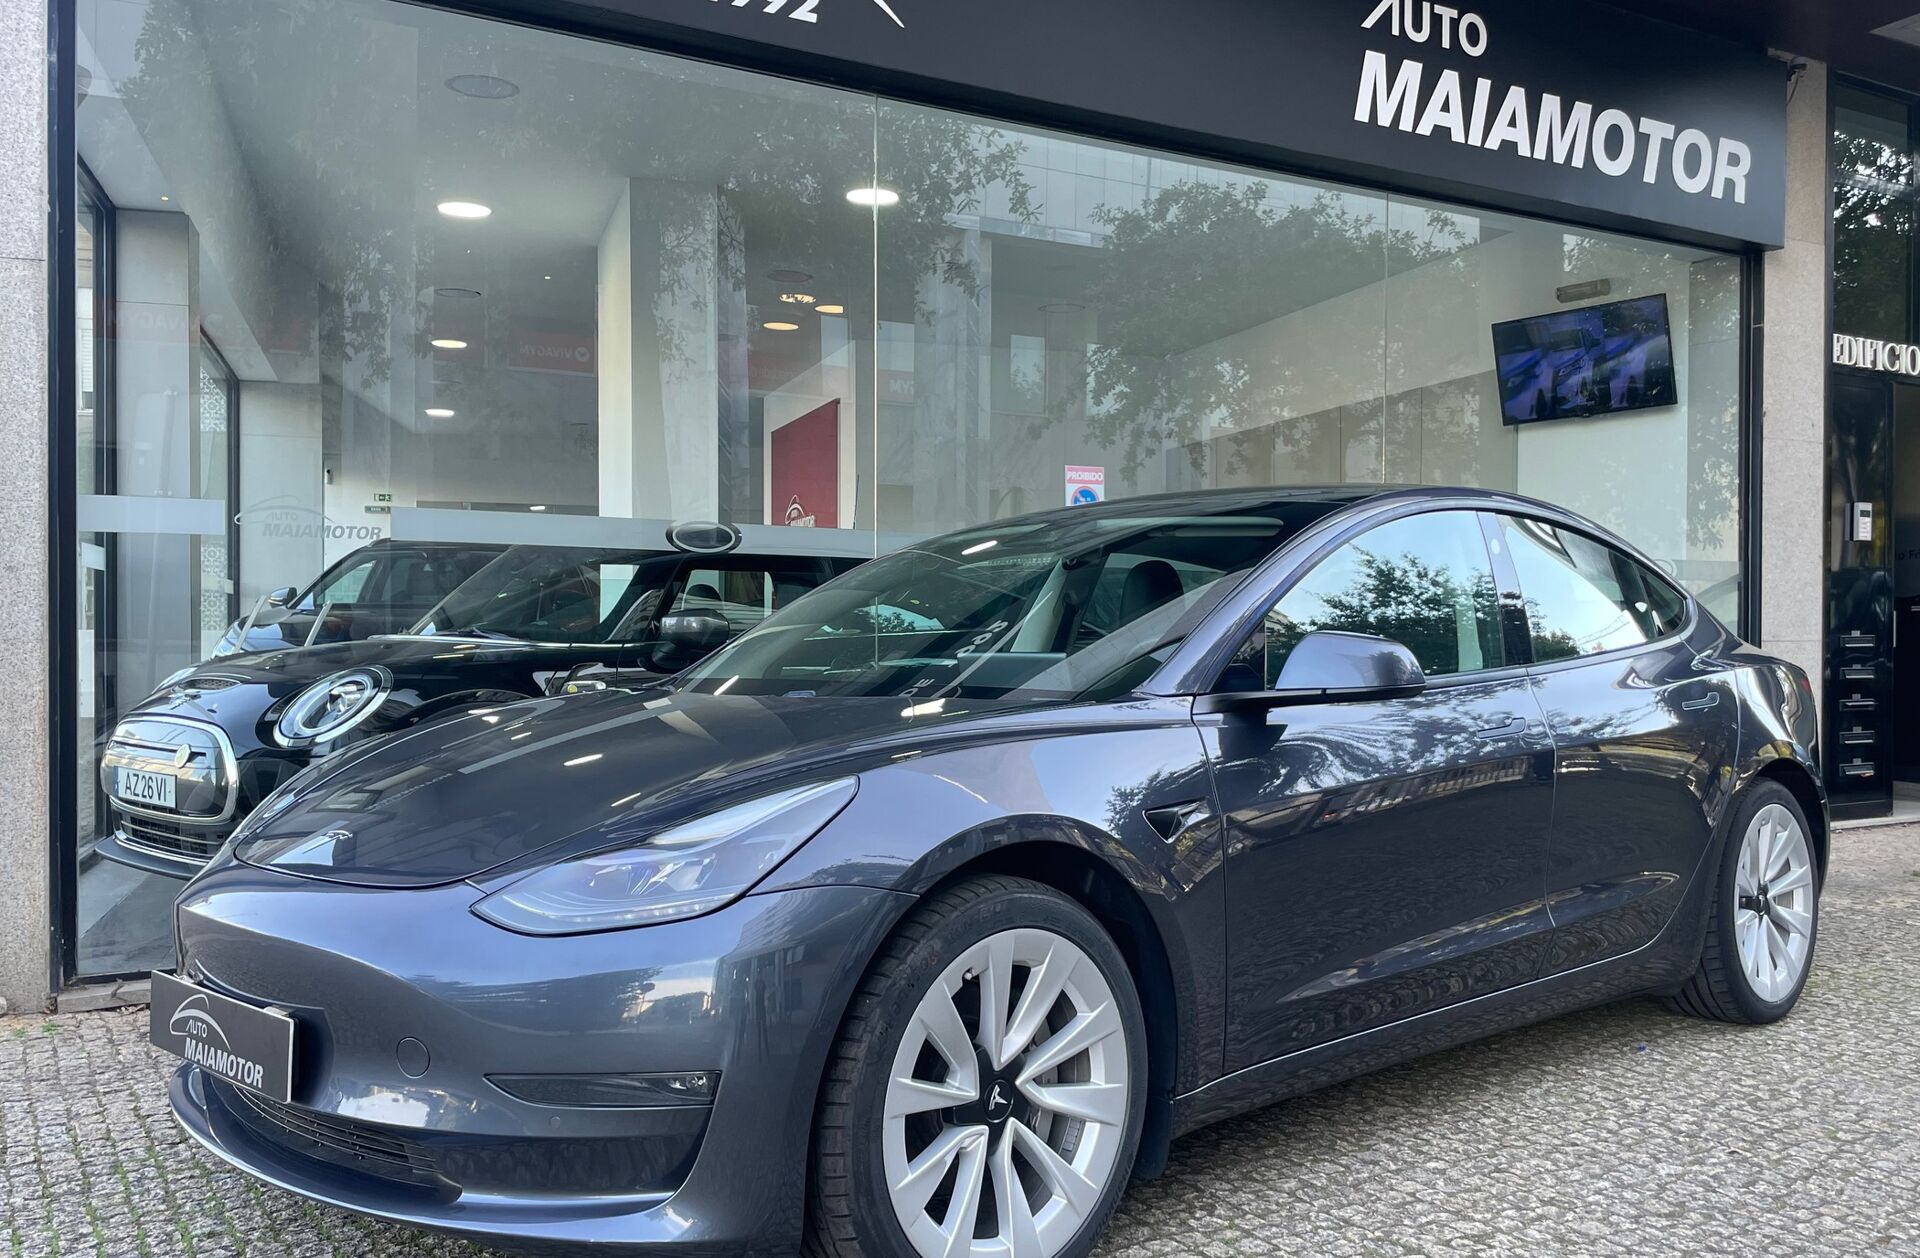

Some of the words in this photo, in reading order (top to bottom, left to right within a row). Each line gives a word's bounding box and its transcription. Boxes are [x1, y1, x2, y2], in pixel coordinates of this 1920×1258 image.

[1360, 0, 1487, 57] AUTO
[1354, 49, 1751, 204] MAIAMOTOR
[1832, 333, 1920, 376] EDIFICIO
[1067, 471, 1104, 481] PROIBIDO
[262, 523, 382, 540] MAIAMOTOR
[186, 1019, 208, 1038] AUTO
[184, 1037, 264, 1088] MAIAMOTOR
